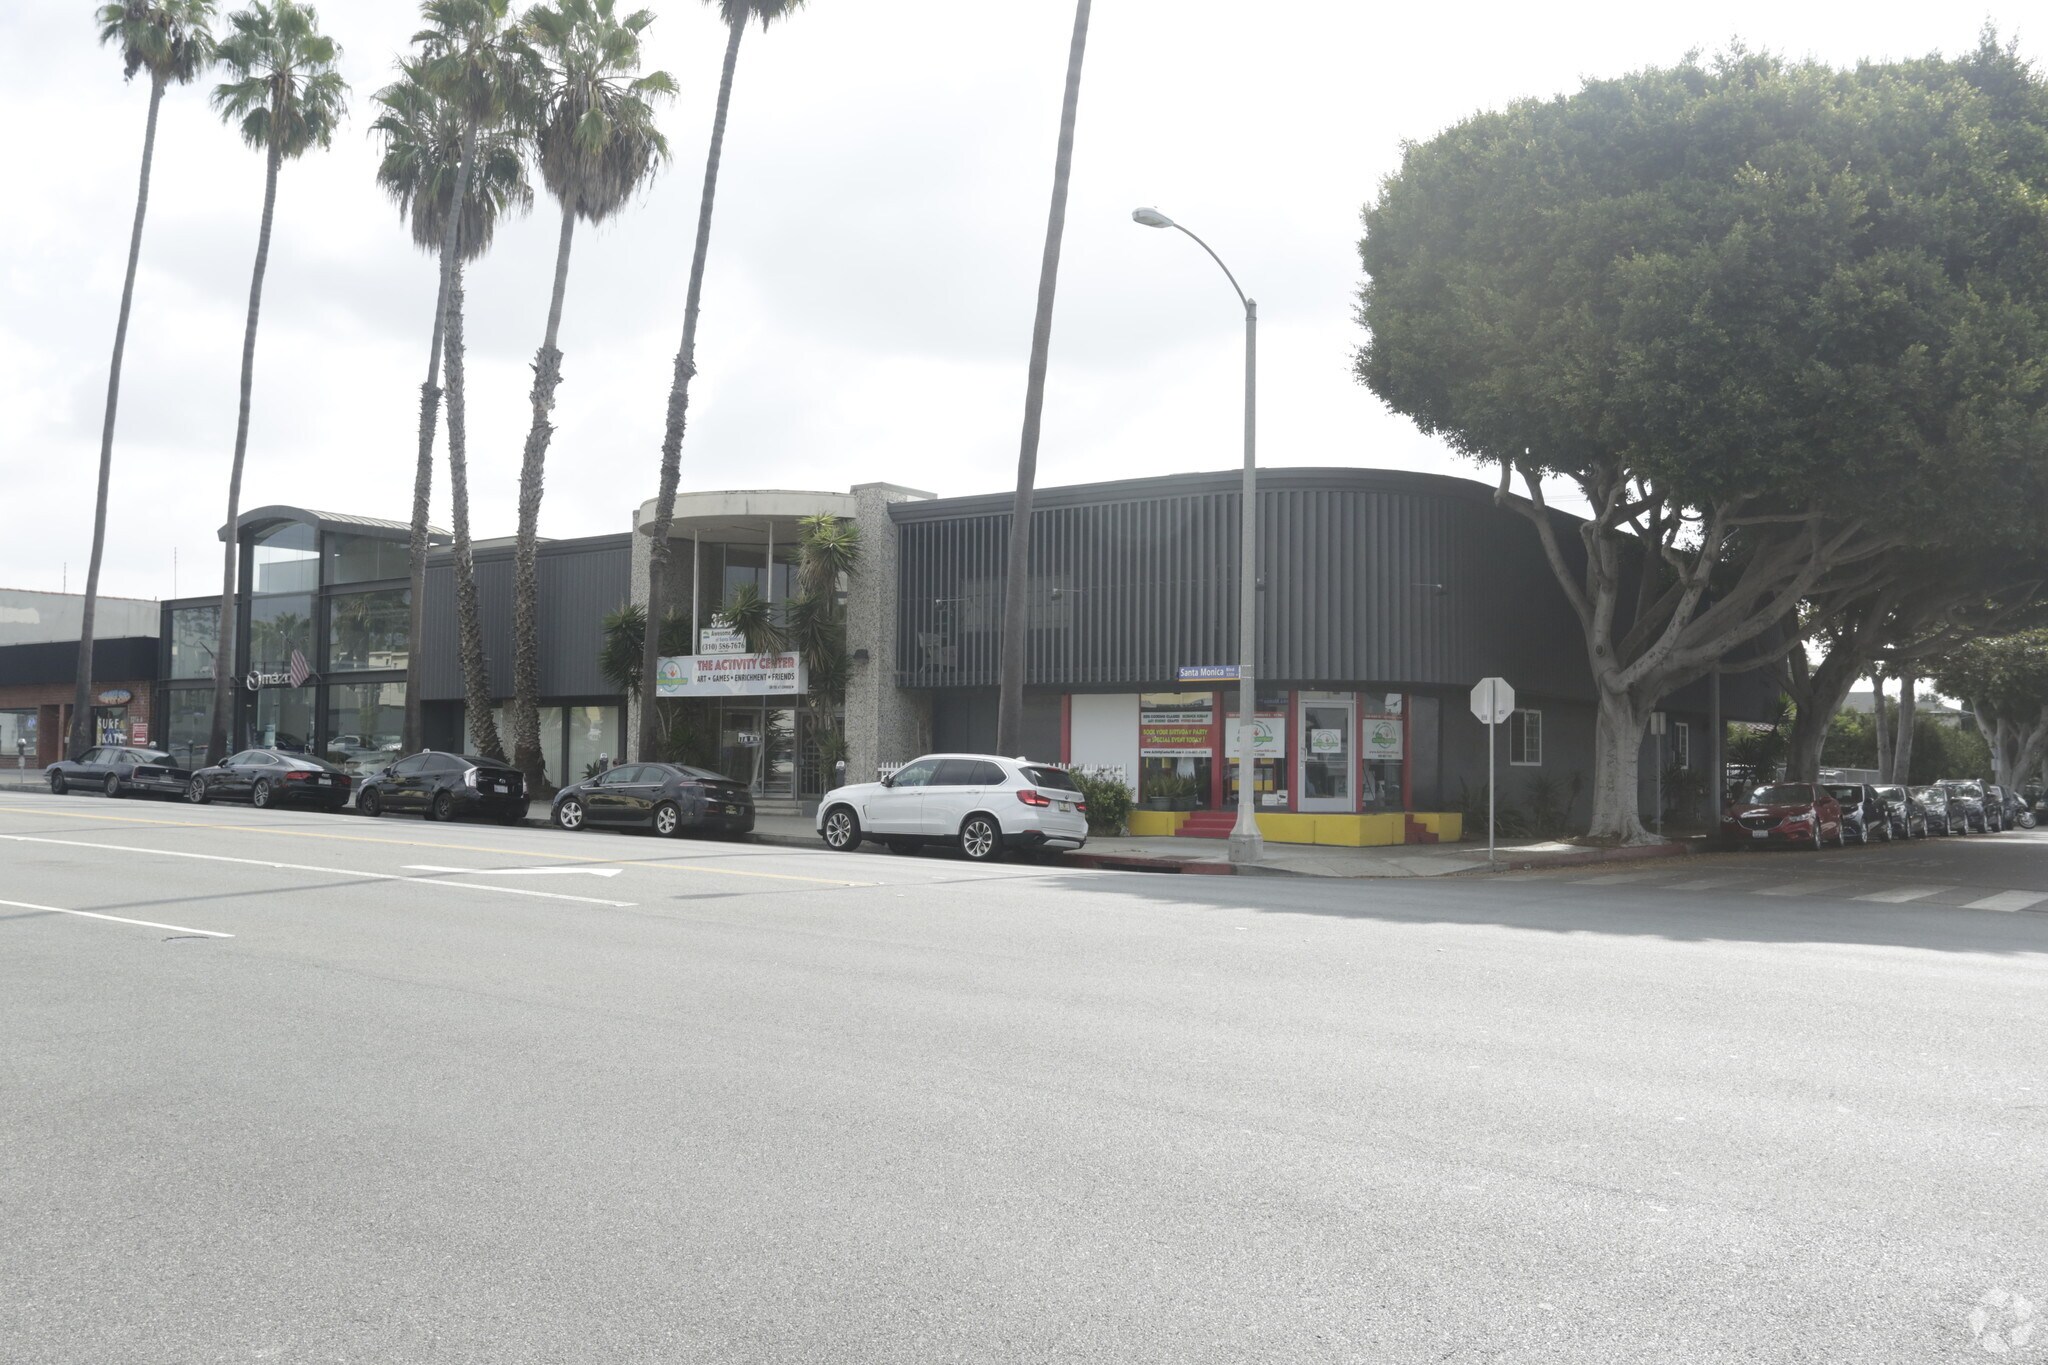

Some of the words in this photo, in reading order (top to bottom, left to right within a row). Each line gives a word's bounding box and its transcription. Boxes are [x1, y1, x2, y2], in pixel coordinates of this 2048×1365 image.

[702, 643, 718, 651] (310)
[697, 660, 713, 671] THE
[714, 658, 757, 671] ACTIVITY
[759, 657, 795, 670] CENTER
[697, 675, 707, 683] ART
[712, 674, 730, 682] GAMES
[734, 673, 767, 682] ENRICHMENT
[771, 672, 795, 681] FRIENDS
[1180, 668, 1199, 677] Santa
[1200, 667, 1224, 676] Monica
[97, 718, 119, 729] SURF
[96, 733, 124, 744] SKATE
